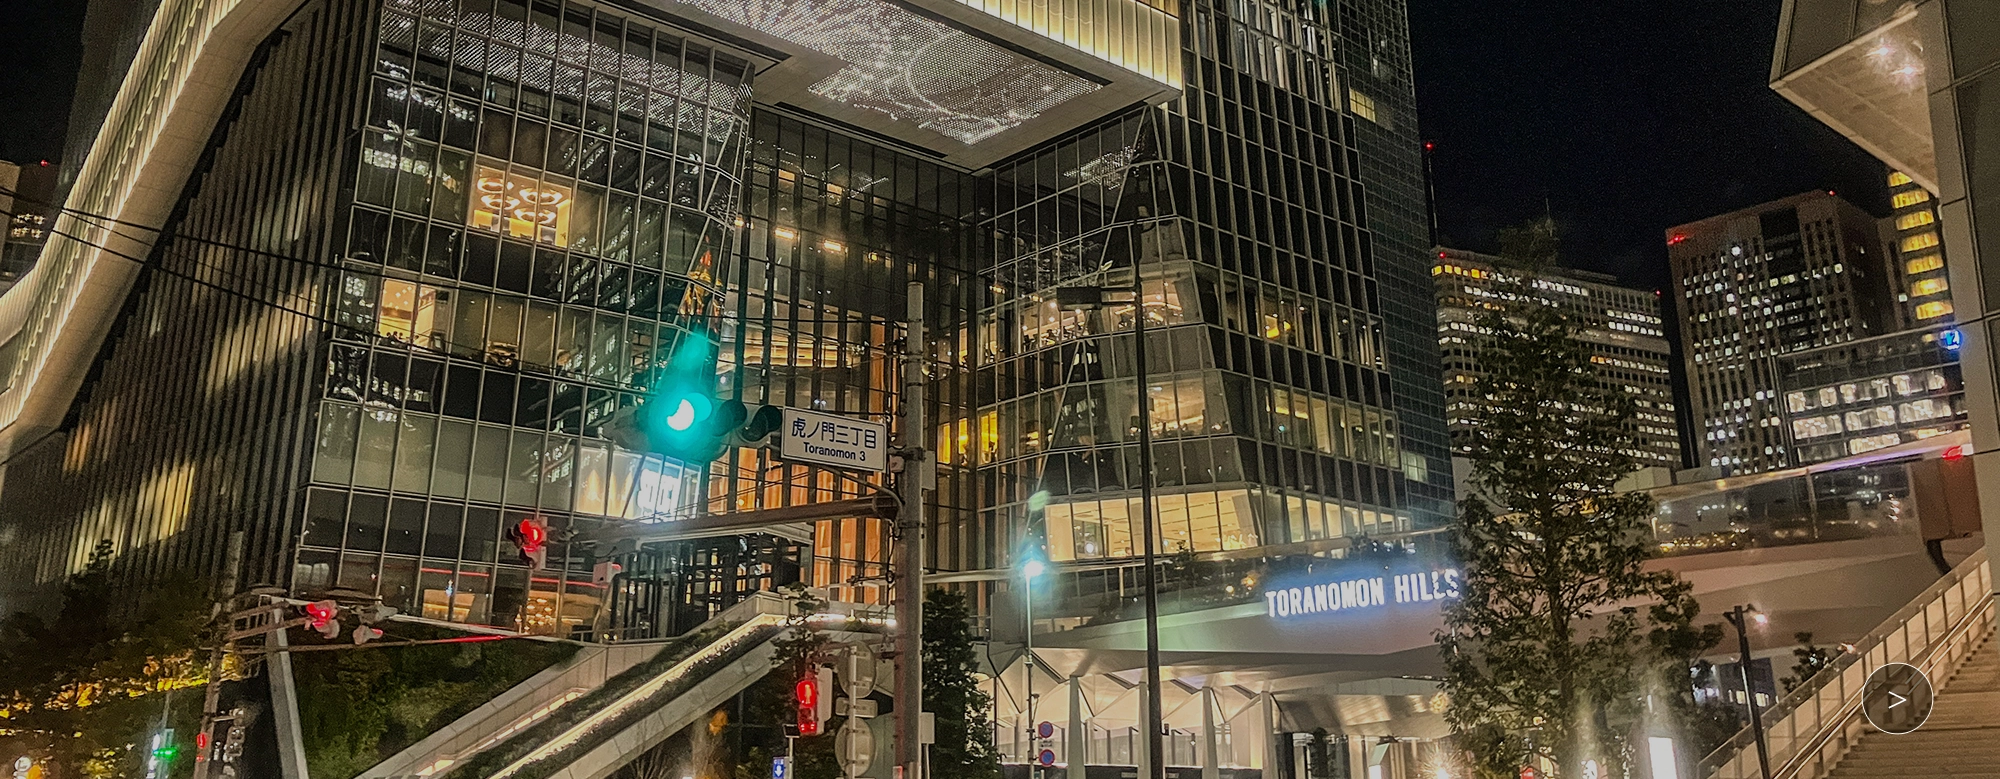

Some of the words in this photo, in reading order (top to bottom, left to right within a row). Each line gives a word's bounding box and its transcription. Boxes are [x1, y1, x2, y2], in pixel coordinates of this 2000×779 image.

[791, 417, 877, 449] 虎ノ門三丁目
[803, 441, 857, 460] Toranomon
[859, 450, 866, 462] 3
[1265, 577, 1385, 618] TORANOMON
[1394, 568, 1460, 603] HILLS
